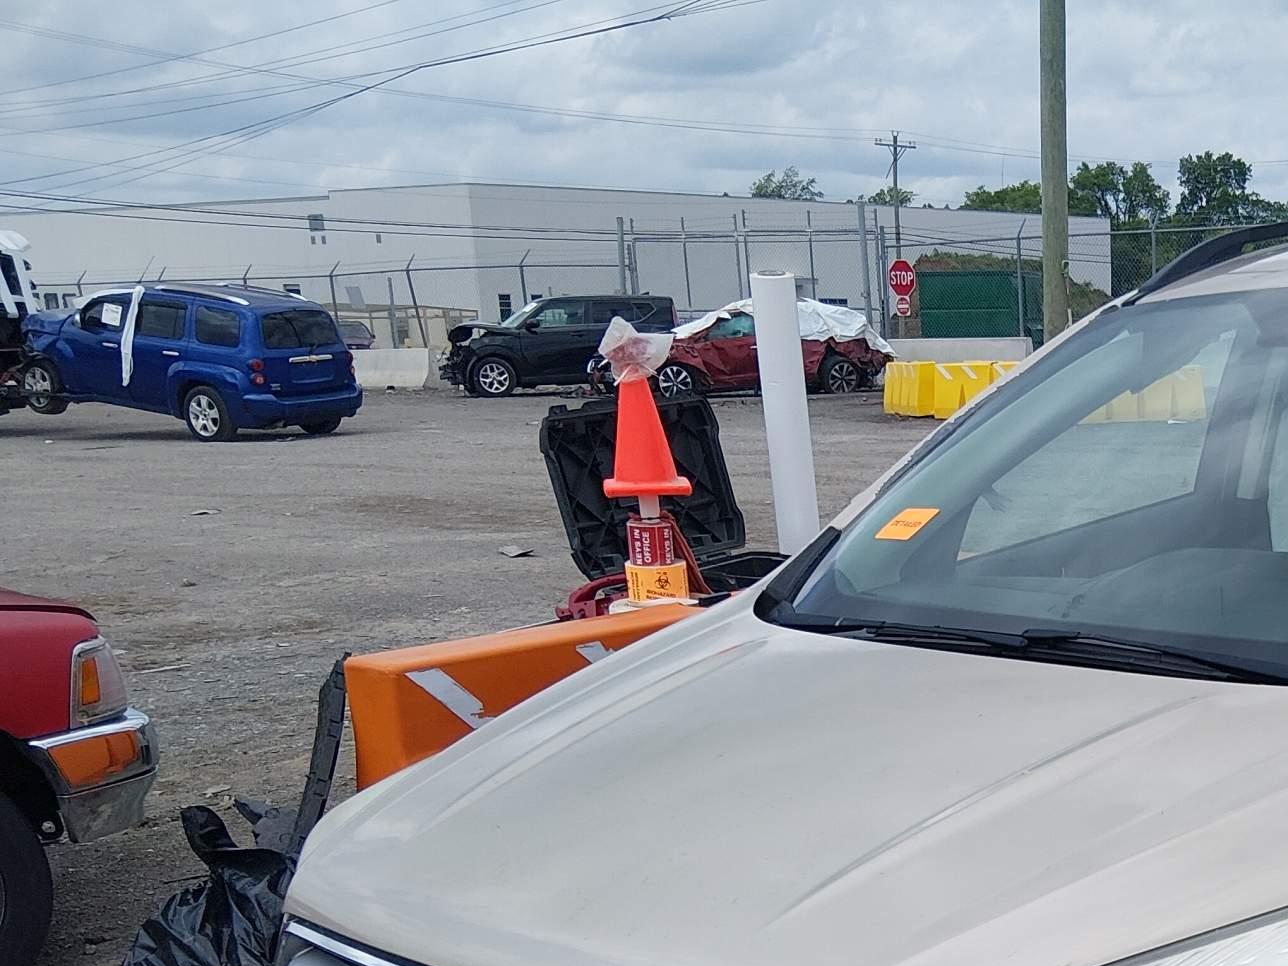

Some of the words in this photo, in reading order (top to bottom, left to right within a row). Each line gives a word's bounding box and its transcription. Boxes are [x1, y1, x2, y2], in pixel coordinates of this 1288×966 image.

[890, 271, 914, 286] STOP
[633, 529, 640, 539] IN
[663, 529, 671, 538] IN
[642, 531, 652, 563] OFFICE
[664, 541, 672, 564] KEYS
